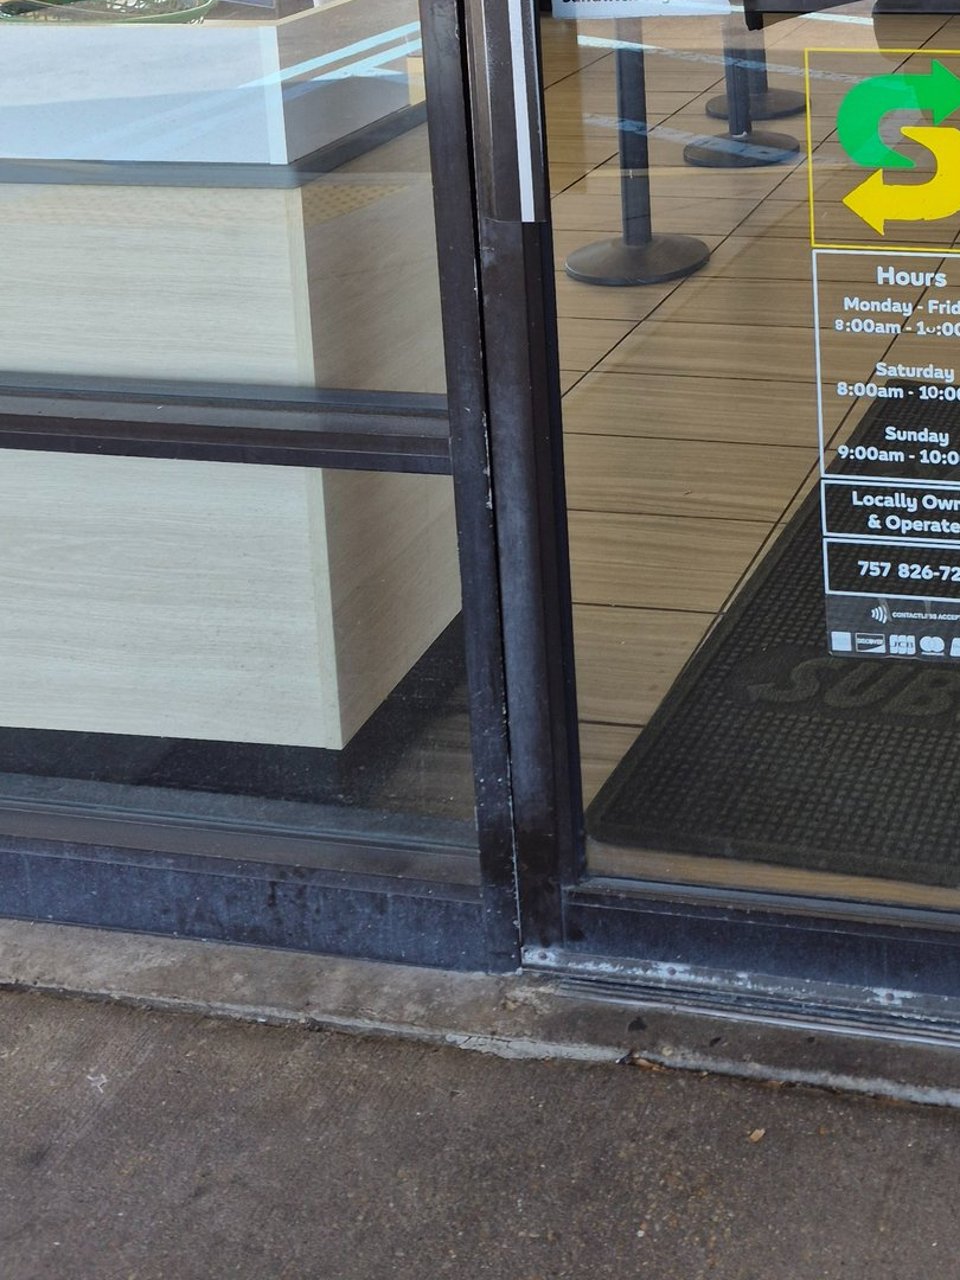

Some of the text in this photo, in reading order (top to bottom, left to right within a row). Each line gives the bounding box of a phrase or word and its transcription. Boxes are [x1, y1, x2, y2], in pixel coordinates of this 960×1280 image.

[877, 266, 948, 288] Hours
[843, 297, 914, 316] Monday
[835, 319, 902, 334] 8:00am
[875, 362, 955, 383] Saturday
[836, 381, 904, 399] 8:00am
[884, 426, 950, 447] Sunday
[837, 445, 905, 462] 9:00am
[852, 491, 918, 513] Locally
[867, 514, 882, 530] &
[857, 560, 892, 577] 757
